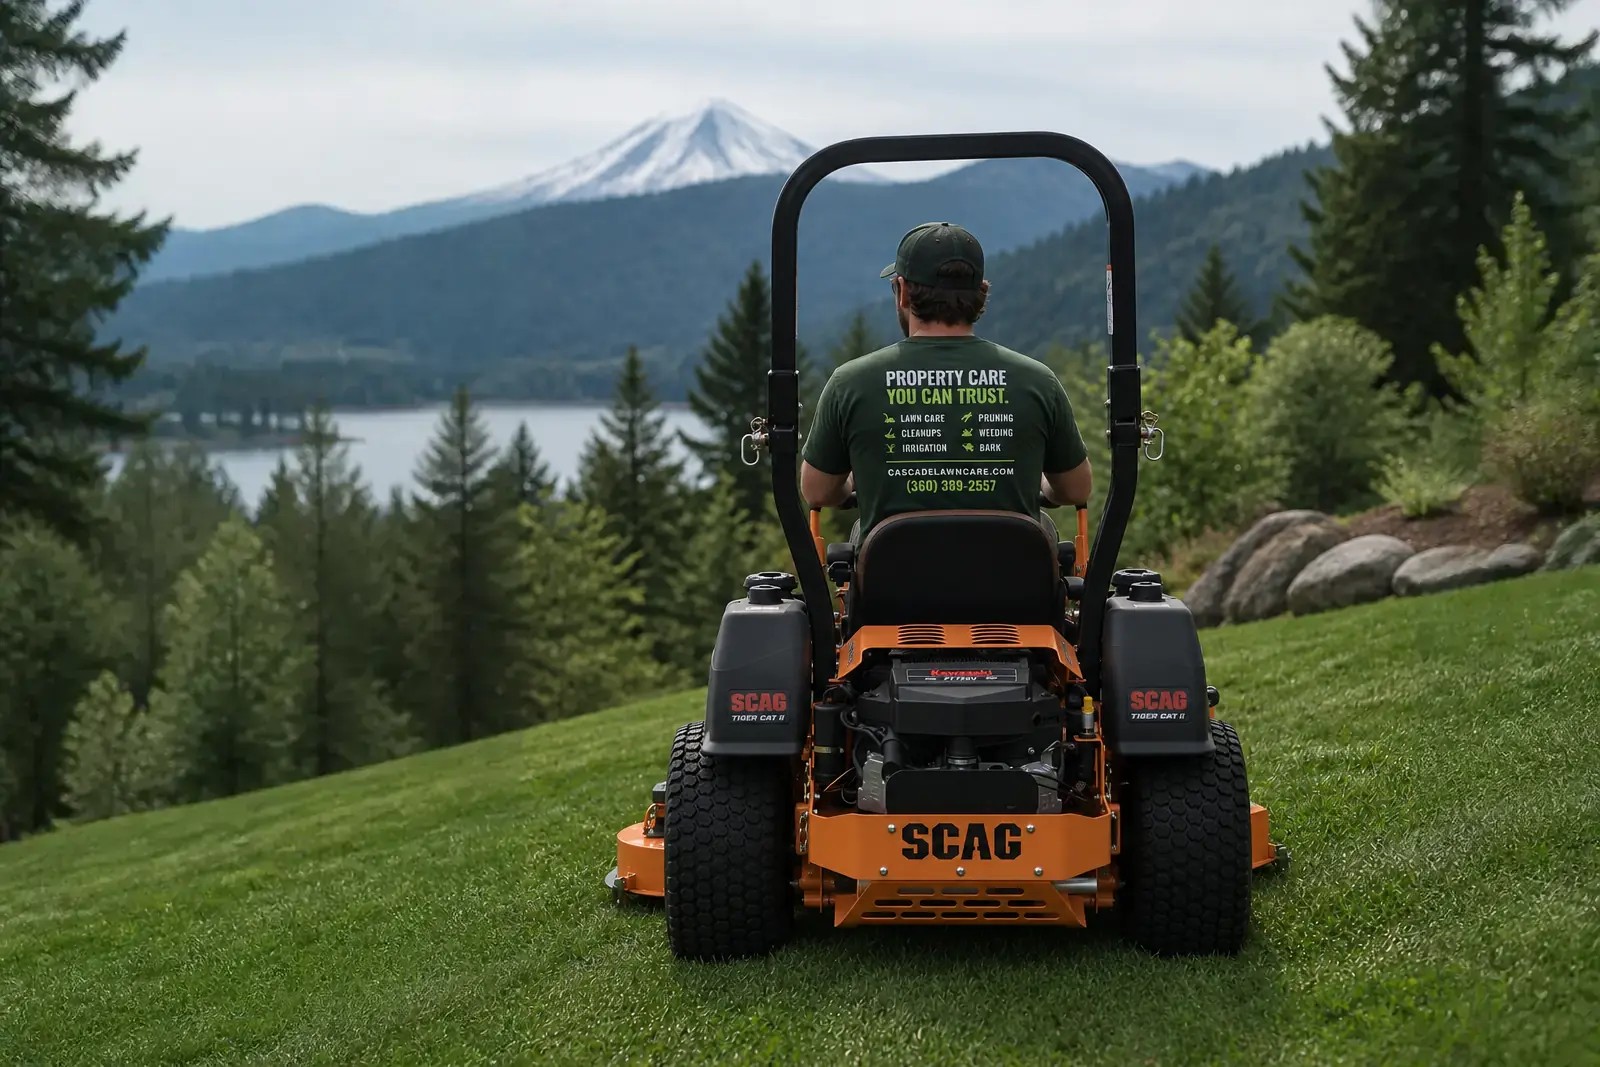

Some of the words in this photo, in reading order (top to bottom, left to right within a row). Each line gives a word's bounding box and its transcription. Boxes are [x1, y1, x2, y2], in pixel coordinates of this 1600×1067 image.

[886, 370, 964, 387] PROPERTY
[968, 369, 1007, 386] CARE
[887, 388, 917, 405] YOU
[921, 388, 953, 405] CAN
[956, 387, 1009, 404] TRUST.
[900, 414, 922, 423] LAWN
[924, 414, 945, 423] CARE
[978, 413, 1014, 423] PRUNING
[901, 429, 942, 438] CLEANUPS
[979, 428, 1014, 438] WEEDING
[902, 444, 947, 453] IRRIGATION
[979, 443, 1001, 452] BARK
[887, 468, 1014, 477] CASCADELAWNCARE.COM
[906, 480, 938, 494] (360)
[941, 480, 996, 492] 389-2557
[731, 693, 787, 712] SCAG
[1130, 690, 1188, 710] SCAG
[902, 823, 1021, 860] SCAG
